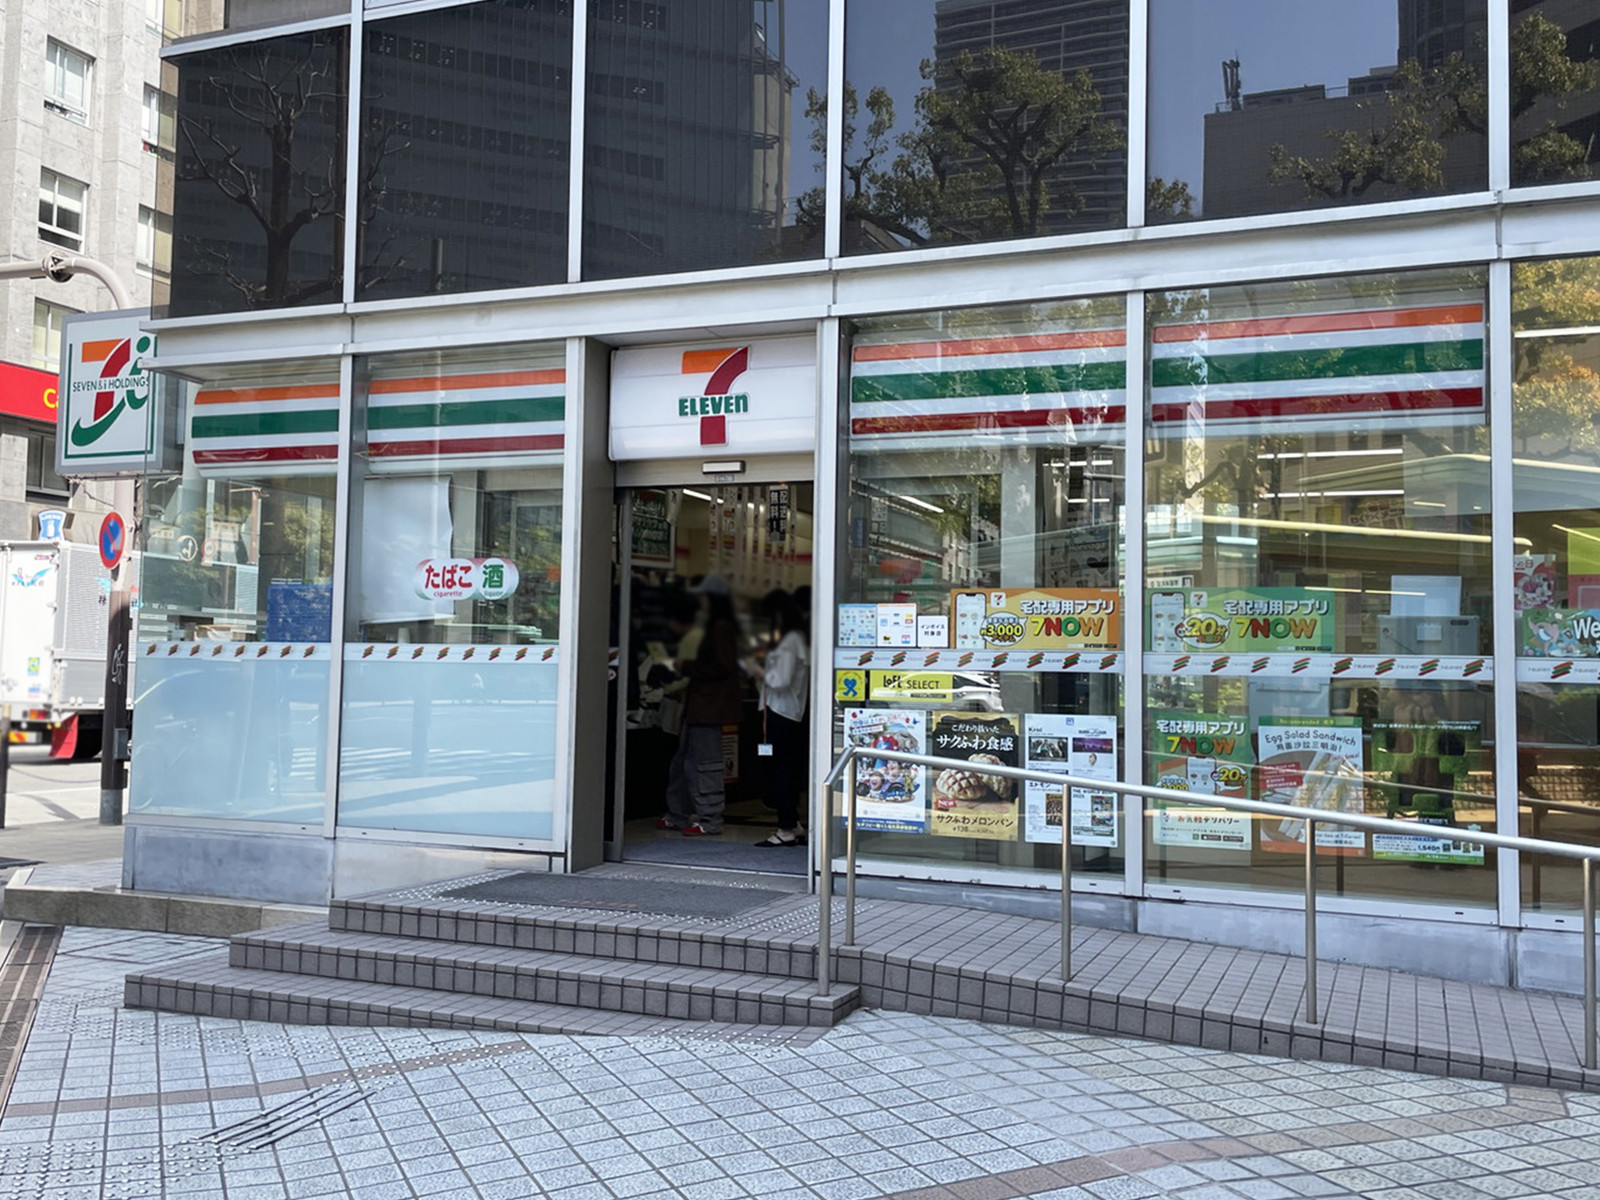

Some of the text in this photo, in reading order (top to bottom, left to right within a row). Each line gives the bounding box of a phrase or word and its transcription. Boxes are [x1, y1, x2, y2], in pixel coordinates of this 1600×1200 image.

[43, 388, 59, 409] C
[425, 565, 473, 589] たばこ
[482, 564, 504, 589] 酒
[433, 590, 462, 598] cigarette
[1020, 599, 1115, 615] 宅配専用アプリ
[1223, 599, 1330, 616] 宅配専用アプリ
[1030, 616, 1105, 637] 7NOW
[1235, 618, 1317, 639] 7NOW
[906, 679, 940, 690] SELECT
[951, 723, 1000, 734] こだわり抜いた
[1156, 719, 1245, 735] 宅配専用アプリ
[936, 734, 1014, 752] サクふわ食感
[1167, 736, 1236, 755] 7NOW
[1265, 730, 1356, 746] Egg Salad Sandwich
[936, 814, 1014, 827] サクふわメロンパン
